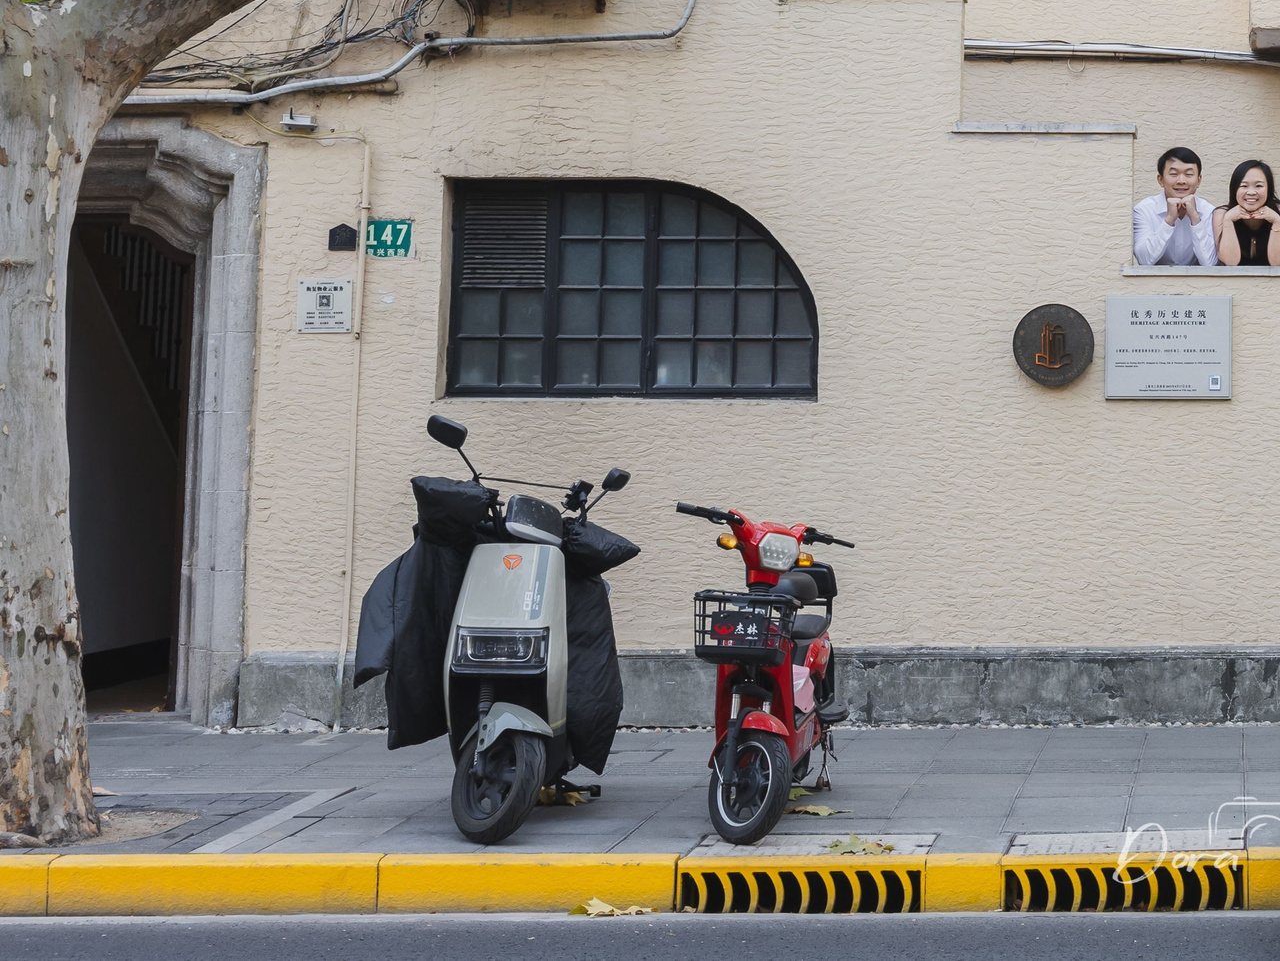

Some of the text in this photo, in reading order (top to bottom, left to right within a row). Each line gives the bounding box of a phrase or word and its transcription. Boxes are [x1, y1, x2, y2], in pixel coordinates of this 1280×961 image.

[366, 224, 408, 245] 147
[1130, 309, 1207, 319] 优秀历史建筑
[734, 622, 759, 635] 杰林
